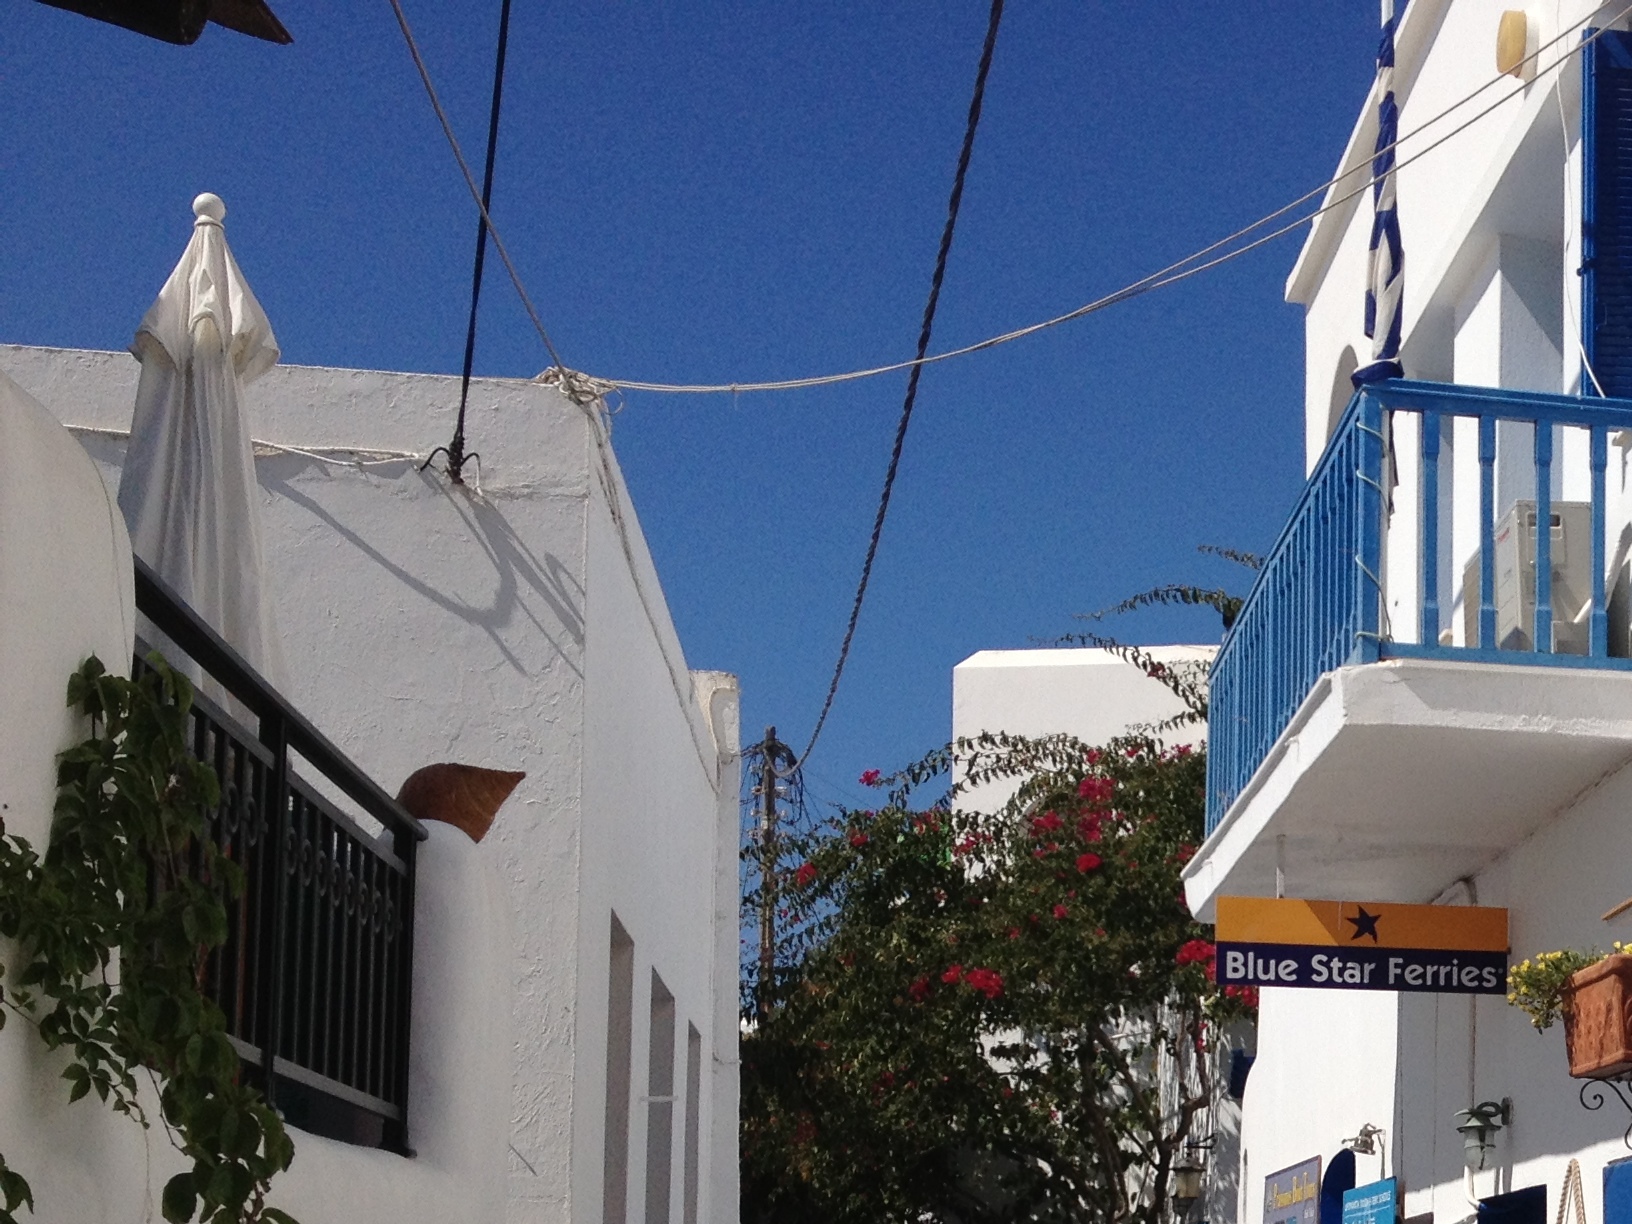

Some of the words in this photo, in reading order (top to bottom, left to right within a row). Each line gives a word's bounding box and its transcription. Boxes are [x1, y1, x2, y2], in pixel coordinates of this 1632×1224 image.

[1226, 951, 1298, 981] Blue
[1311, 954, 1376, 984] Star
[1388, 957, 1497, 987] Ferries
